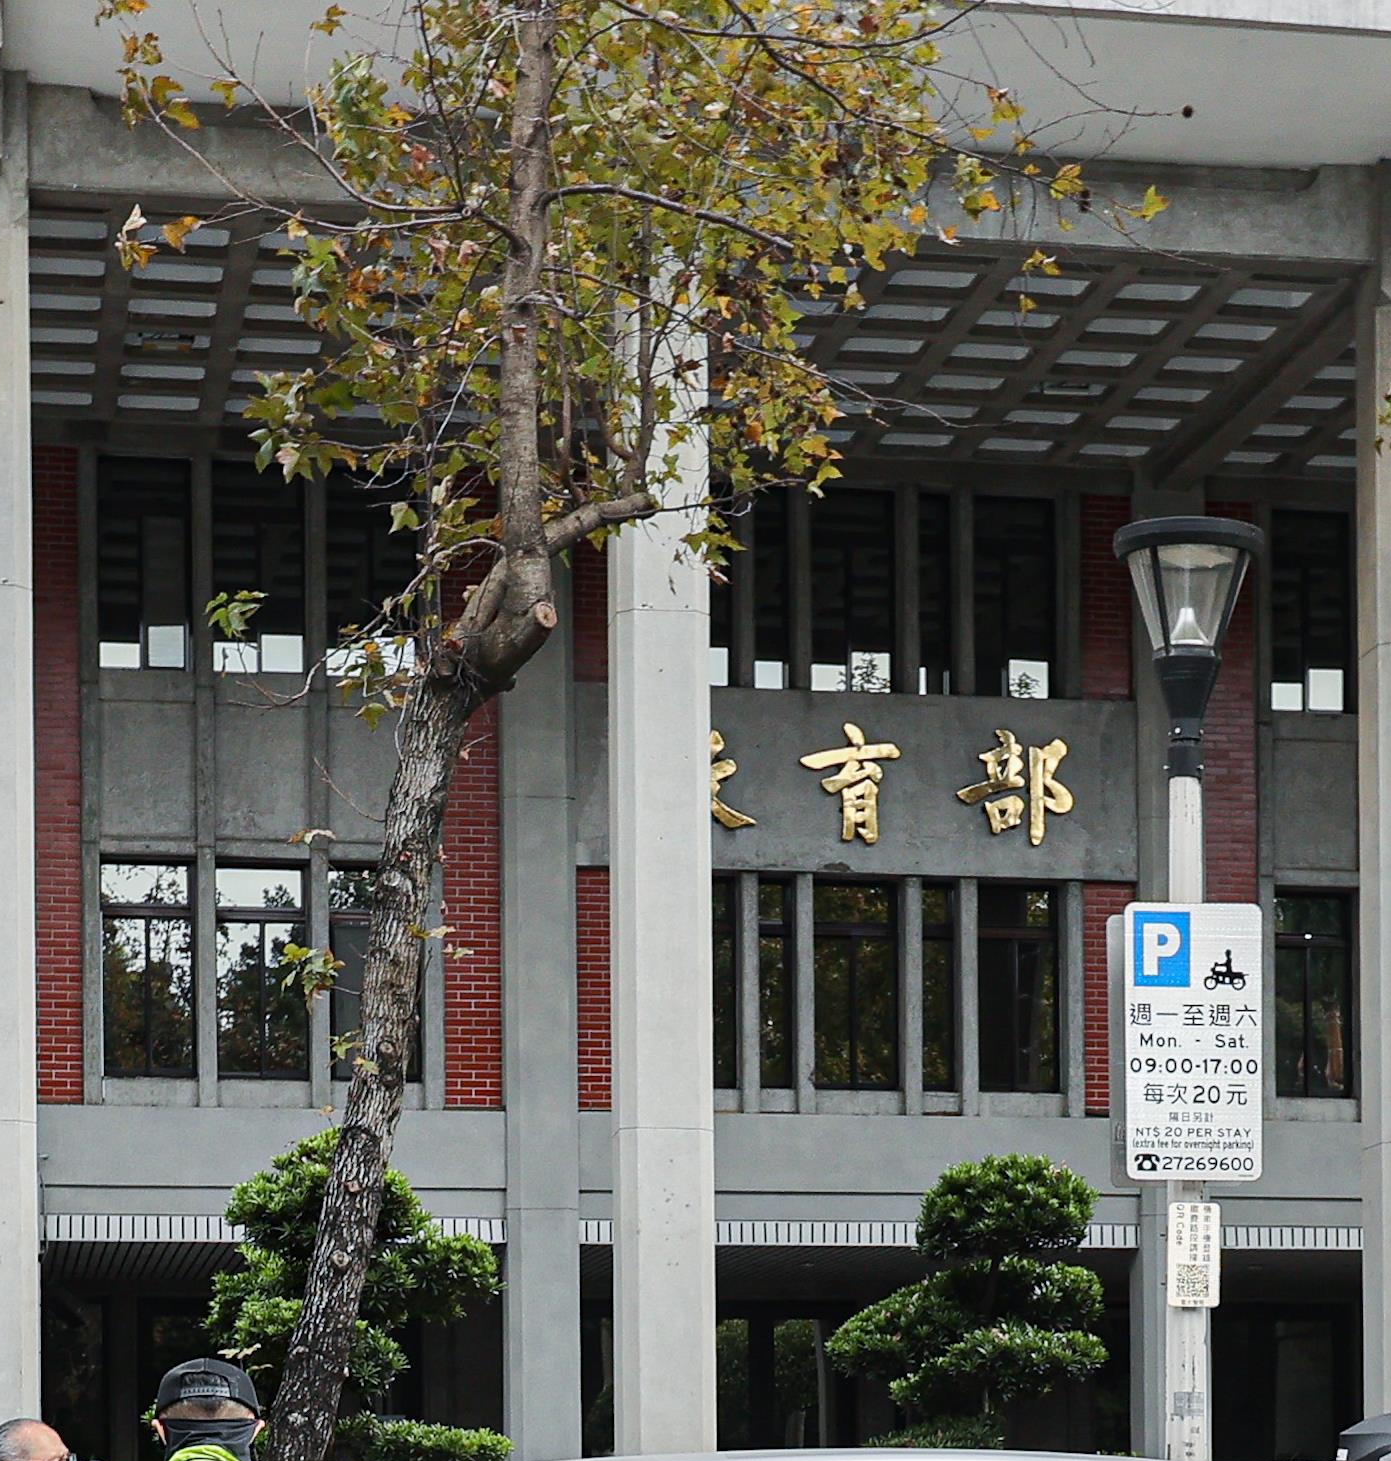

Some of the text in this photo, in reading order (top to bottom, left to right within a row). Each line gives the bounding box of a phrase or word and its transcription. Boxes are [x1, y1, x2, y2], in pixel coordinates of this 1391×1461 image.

[1143, 922, 1181, 976] P
[1129, 1003, 1257, 1027] 週一至週六
[1139, 1033, 1182, 1049] Mon.
[1215, 1033, 1249, 1049] Sat.
[1130, 1057, 1258, 1075] 09:00-17:00
[1143, 1083, 1248, 1106] 每次20元
[1136, 1126, 1252, 1138] NT$ 20 PER STAY
[1132, 1138, 1255, 1152] (extra fee for overnight parking)
[1161, 1156, 1254, 1171] 27269600
